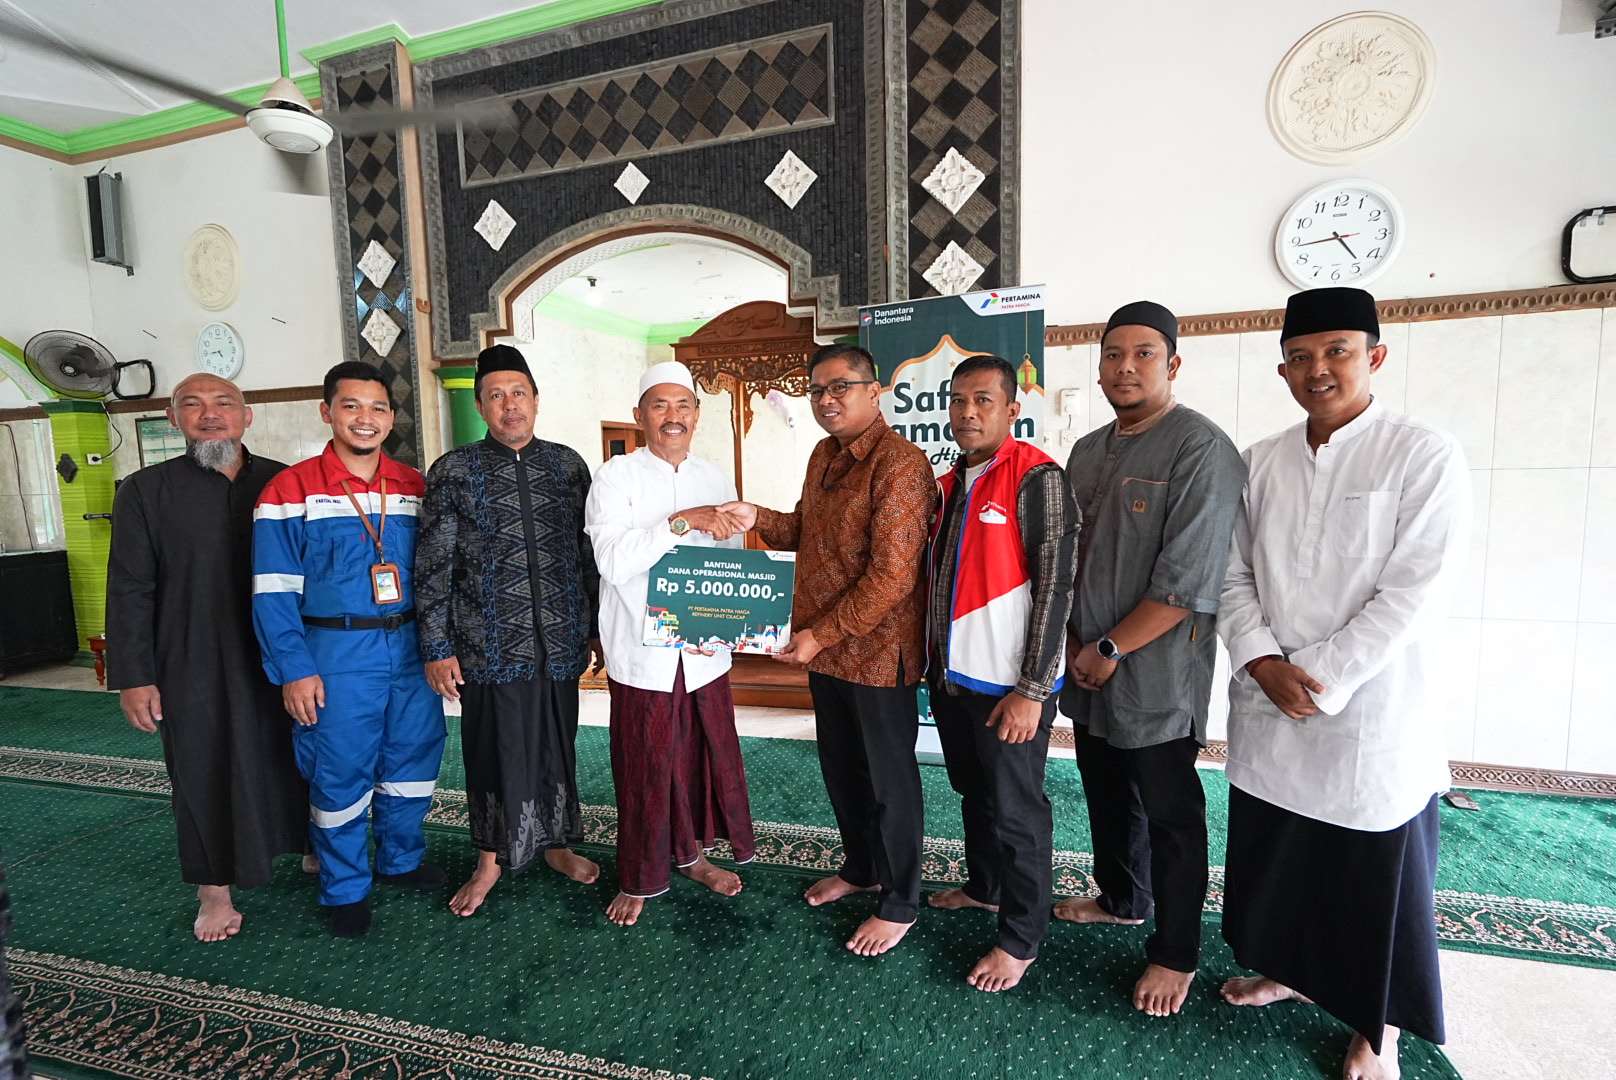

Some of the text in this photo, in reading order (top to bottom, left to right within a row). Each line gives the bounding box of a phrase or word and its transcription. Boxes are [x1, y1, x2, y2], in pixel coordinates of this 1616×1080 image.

[1333, 194, 1350, 207] 12
[1358, 197, 1364, 209] 1
[1314, 202, 1326, 214] 11
[1368, 209, 1381, 222] 2
[1296, 217, 1312, 229] 10
[1374, 228, 1388, 240] 3
[1291, 236, 1301, 247] 9
[1296, 253, 1309, 265] 8
[1366, 247, 1381, 259] 4
[1311, 265, 1322, 277] 7
[1349, 262, 1361, 274] 5
[1330, 268, 1341, 281] 6
[1001, 293, 1041, 303] PERTAMINA
[874, 307, 914, 318] Danantara
[874, 314, 912, 325] Indonesia
[894, 379, 951, 414] Saf
[704, 561, 742, 570] BANTUAN
[668, 566, 776, 581] DANA OPERASIONAL MASJID
[656, 577, 785, 602] Rp 5.000.000,-
